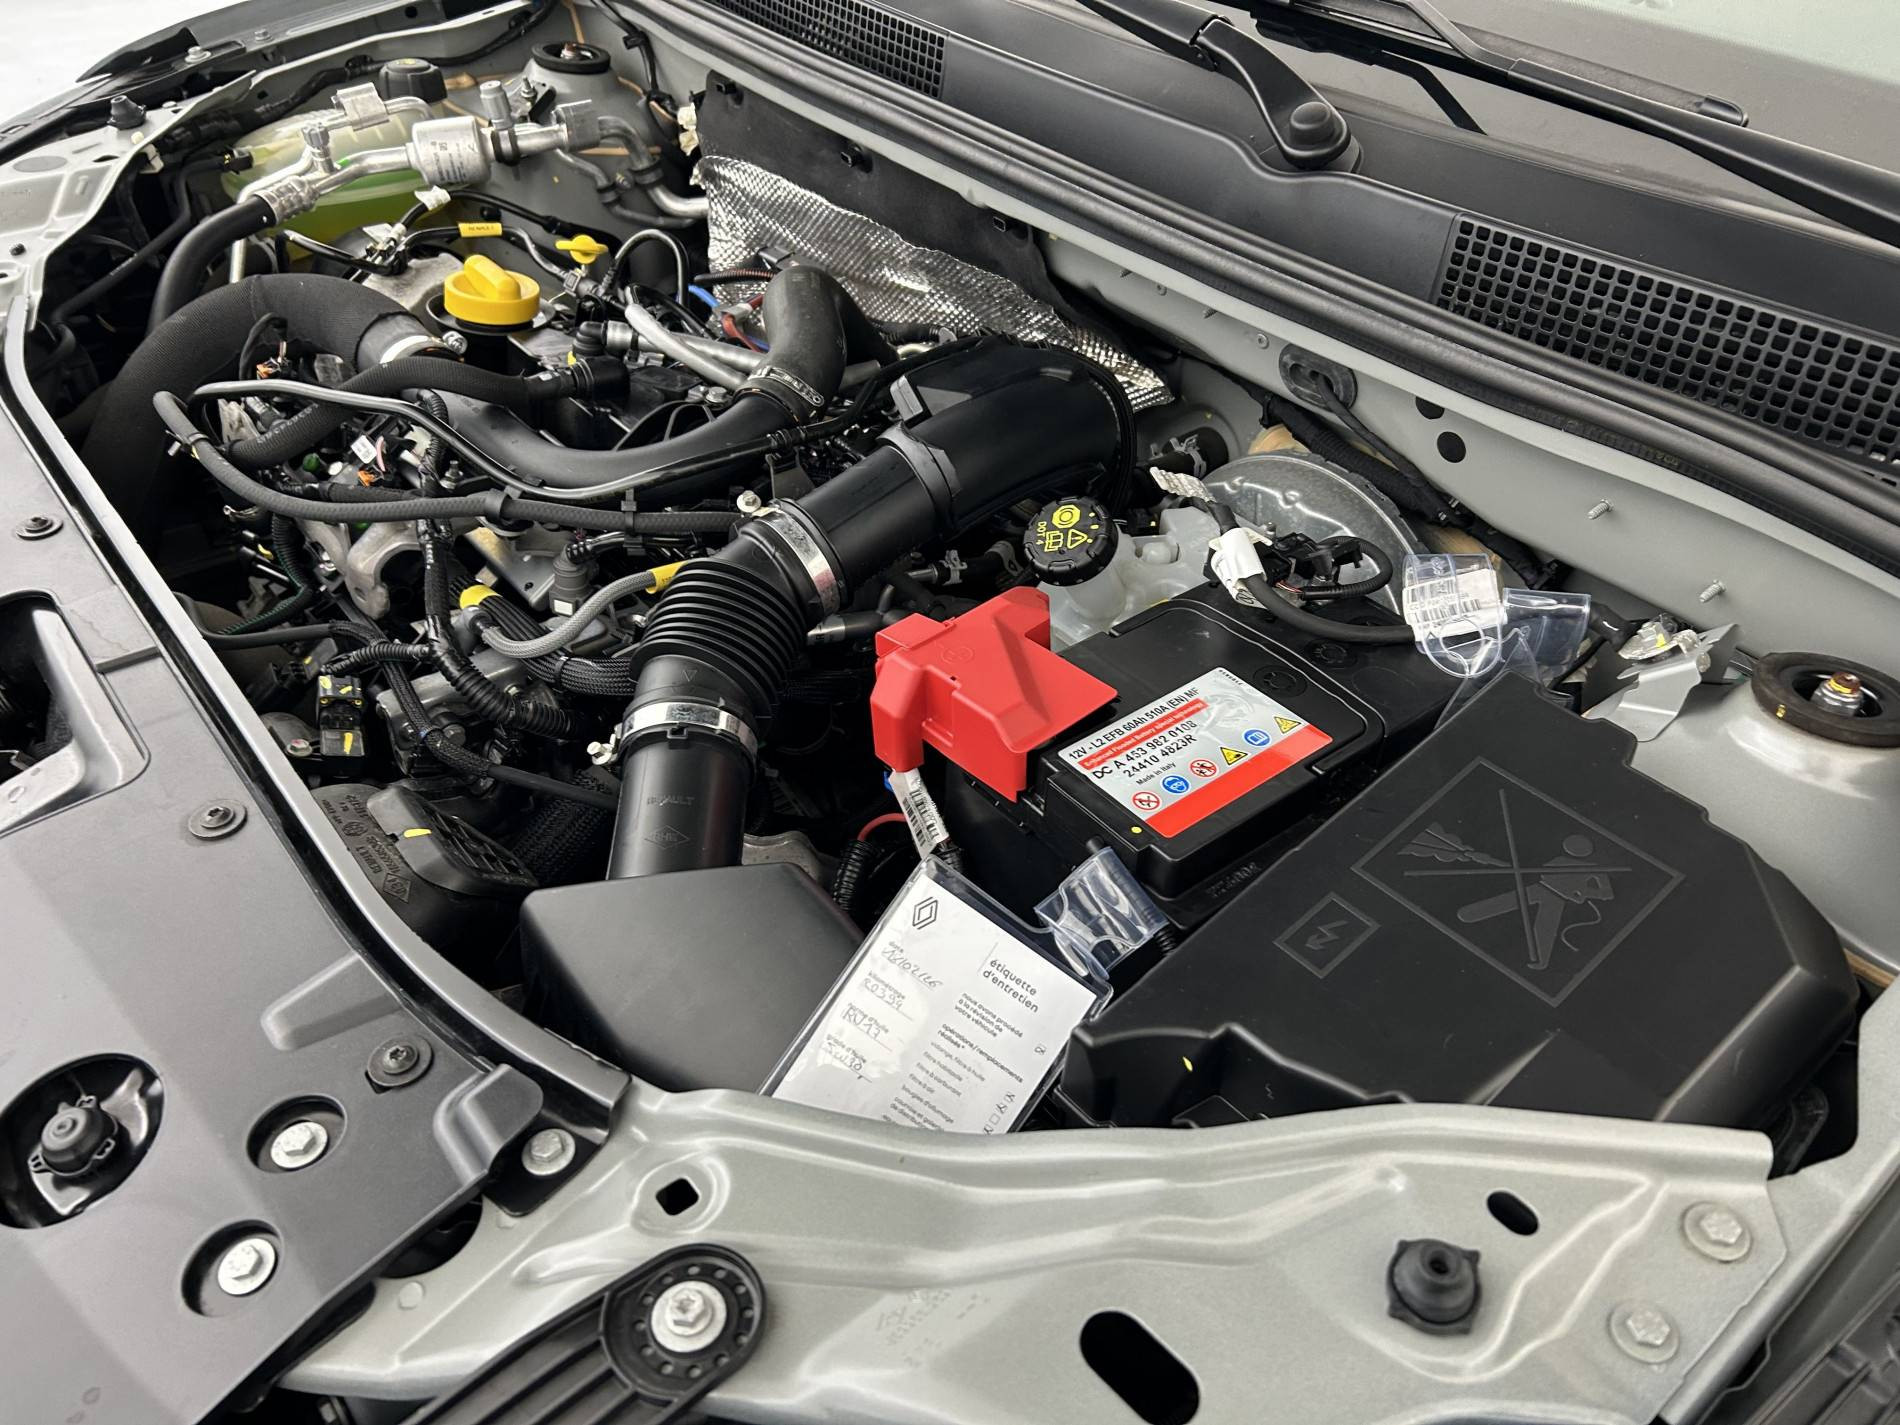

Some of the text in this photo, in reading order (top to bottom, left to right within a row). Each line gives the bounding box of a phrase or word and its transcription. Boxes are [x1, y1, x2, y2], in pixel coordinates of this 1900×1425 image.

[1037, 521, 1047, 537] DOT
[1068, 747, 1088, 760] 12V
[1091, 738, 1106, 748] L2
[1103, 728, 1125, 741] EFB
[1122, 716, 1148, 731] 60Ah
[1144, 704, 1170, 719] 510A
[1165, 694, 1189, 708] (EN)
[1183, 687, 1201, 698] MF
[1111, 759, 1125, 768] A
[1123, 746, 1148, 762] 453
[1145, 735, 1169, 749] 982
[1167, 719, 1197, 738] 0108
[1123, 734, 1197, 777] 24410 4823R
[1135, 772, 1155, 785] Made
[1159, 761, 1177, 772] Italy
[981, 968, 1040, 1012] d'entretien
[988, 957, 1039, 996] étiquette
[954, 1005, 998, 1037] votre véhicule
[961, 993, 1023, 1037] nous avons procédé
[969, 1006, 995, 1026] révision
[994, 1023, 1003, 1032] de
